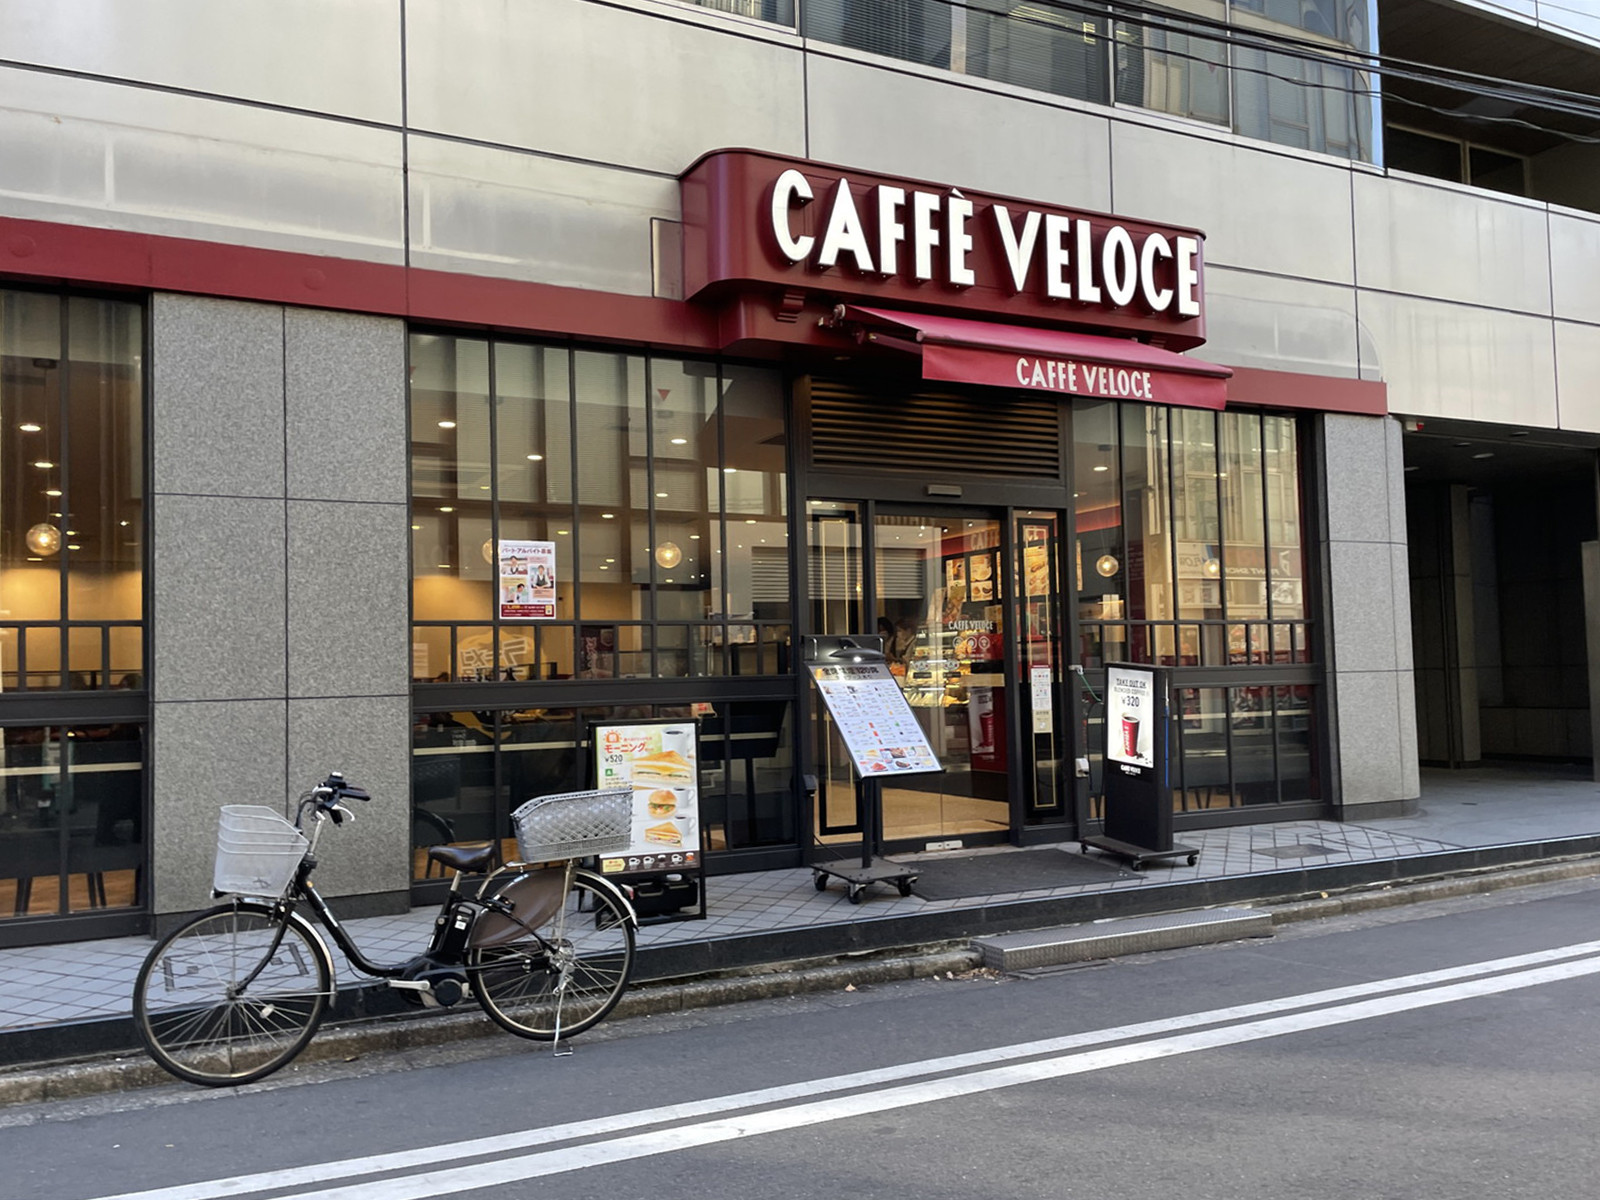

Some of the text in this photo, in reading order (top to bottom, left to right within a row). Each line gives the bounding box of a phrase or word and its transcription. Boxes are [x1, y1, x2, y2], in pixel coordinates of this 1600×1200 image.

[771, 168, 1200, 318] CAFFÈ VELOCE
[1016, 356, 1153, 400] CAFFÈ VELOCE
[604, 741, 646, 754] モーニング
[604, 754, 623, 763] ¥520
